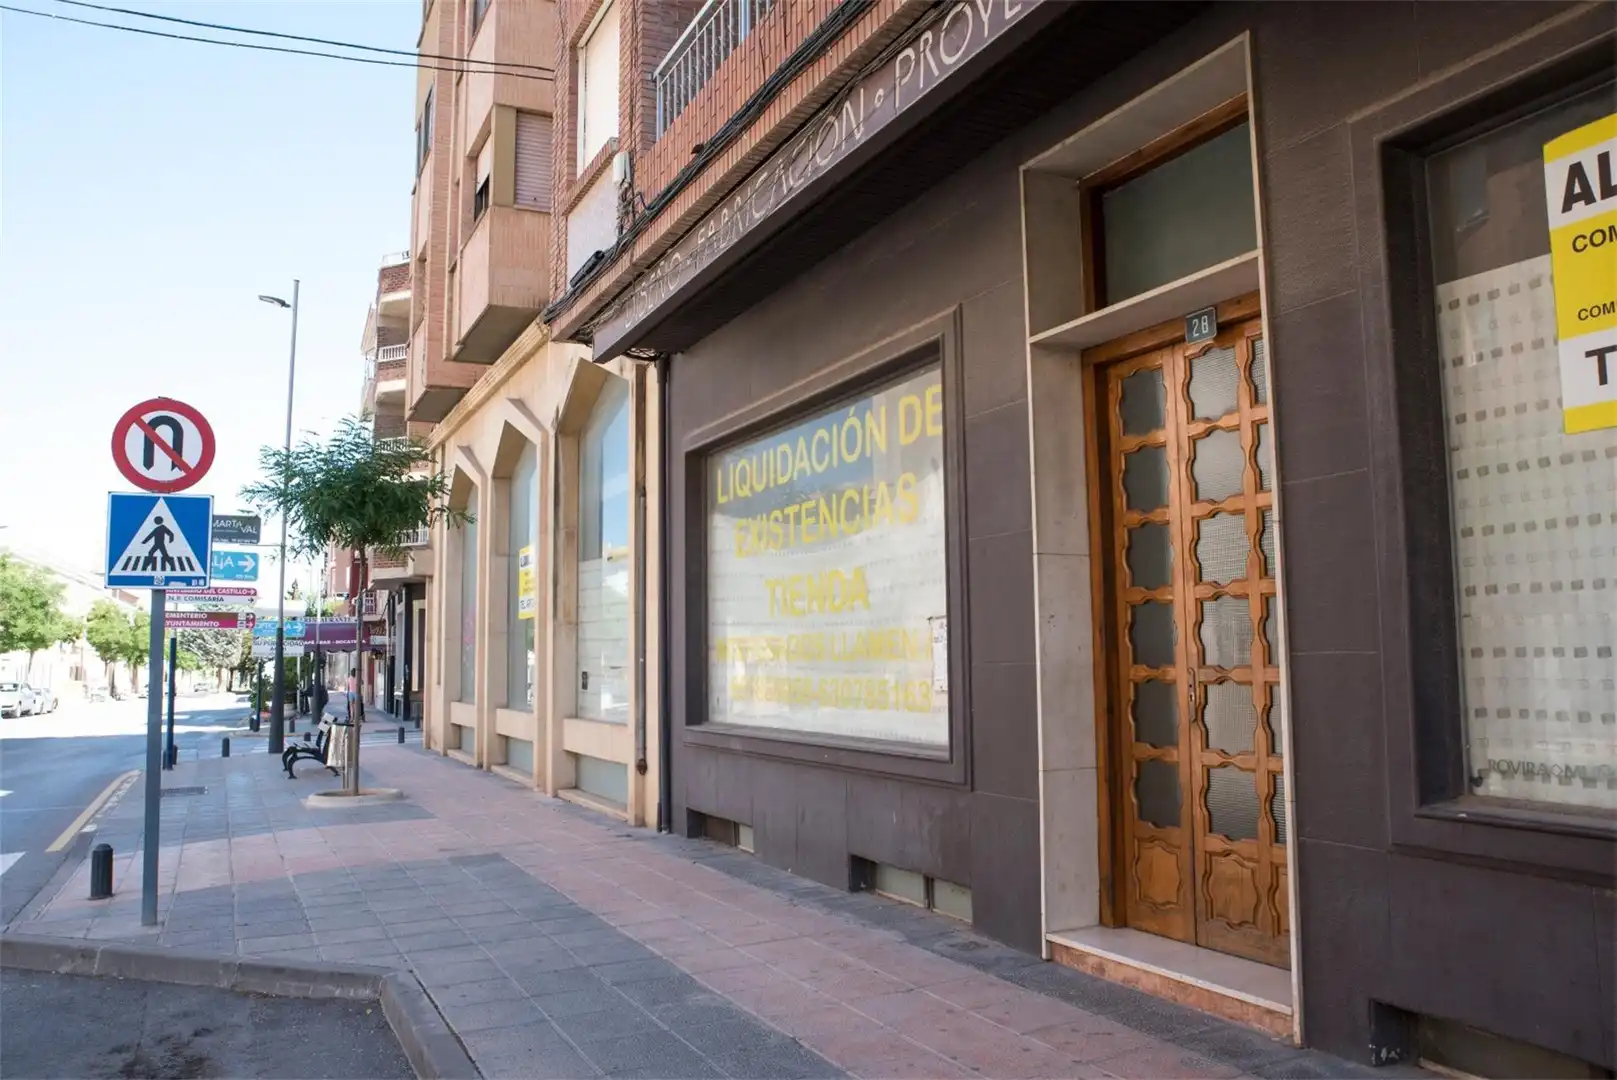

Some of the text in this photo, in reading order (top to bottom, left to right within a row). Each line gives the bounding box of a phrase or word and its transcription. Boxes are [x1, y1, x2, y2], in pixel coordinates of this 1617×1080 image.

[895, 0, 1021, 108] PROY
[1561, 151, 1617, 214] AL
[1192, 315, 1209, 337] 28
[716, 384, 943, 504] LIQUIDACIÓN DE
[734, 472, 920, 558] EXISTENCIAS
[765, 565, 871, 618] TIENDA
